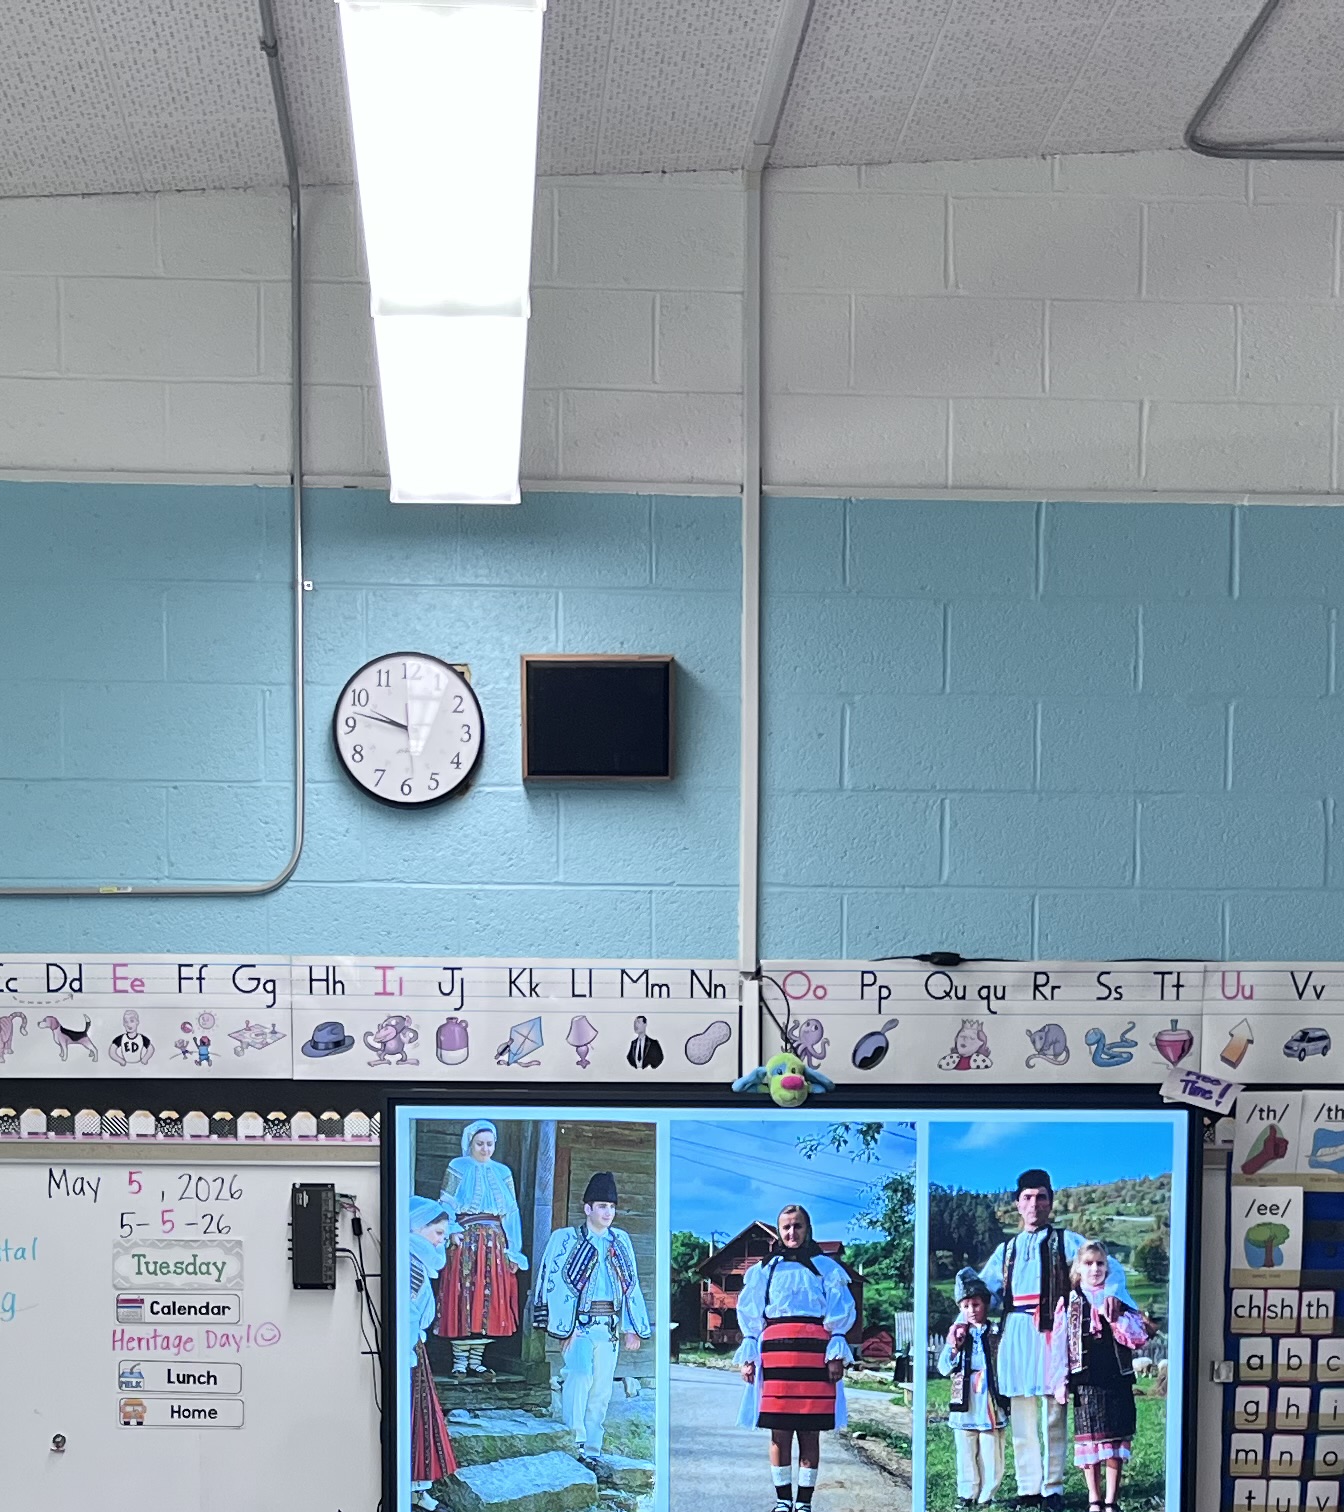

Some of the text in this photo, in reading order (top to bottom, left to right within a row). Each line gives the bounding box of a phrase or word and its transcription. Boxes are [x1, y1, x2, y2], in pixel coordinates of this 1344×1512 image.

[47, 1168, 243, 1202] May 2026
[132, 1254, 226, 1281] Tuesday
[150, 1301, 230, 1316] Calendar
[112, 1326, 250, 1353] Heritage Day!
[167, 1370, 217, 1386] Lunch
[170, 1405, 217, 1419] Home
